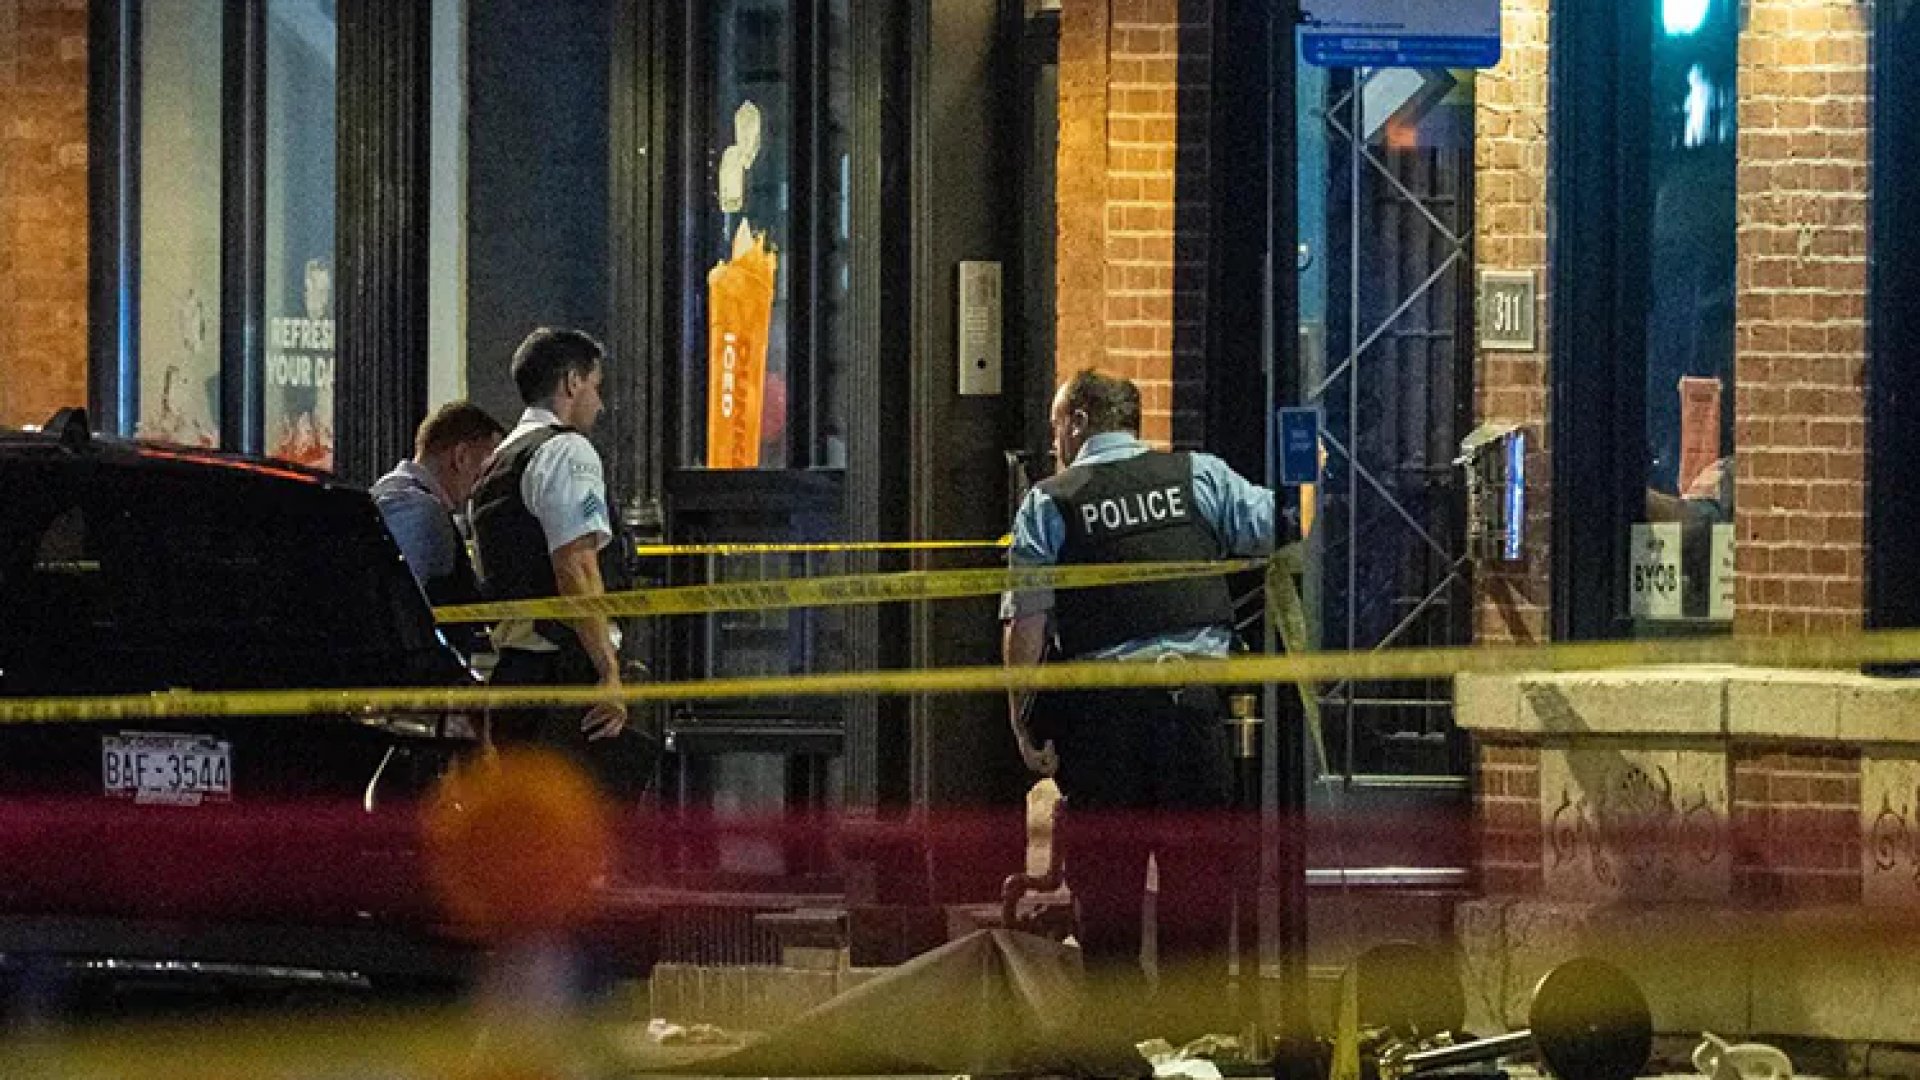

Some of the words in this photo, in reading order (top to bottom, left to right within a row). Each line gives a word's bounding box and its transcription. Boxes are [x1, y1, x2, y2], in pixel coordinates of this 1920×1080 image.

[1493, 290, 1519, 331] 311
[266, 354, 311, 387] YOUR
[1081, 486, 1186, 535] POLICE
[1634, 564, 1677, 594] BYOB
[106, 751, 227, 790] BAF-3544
